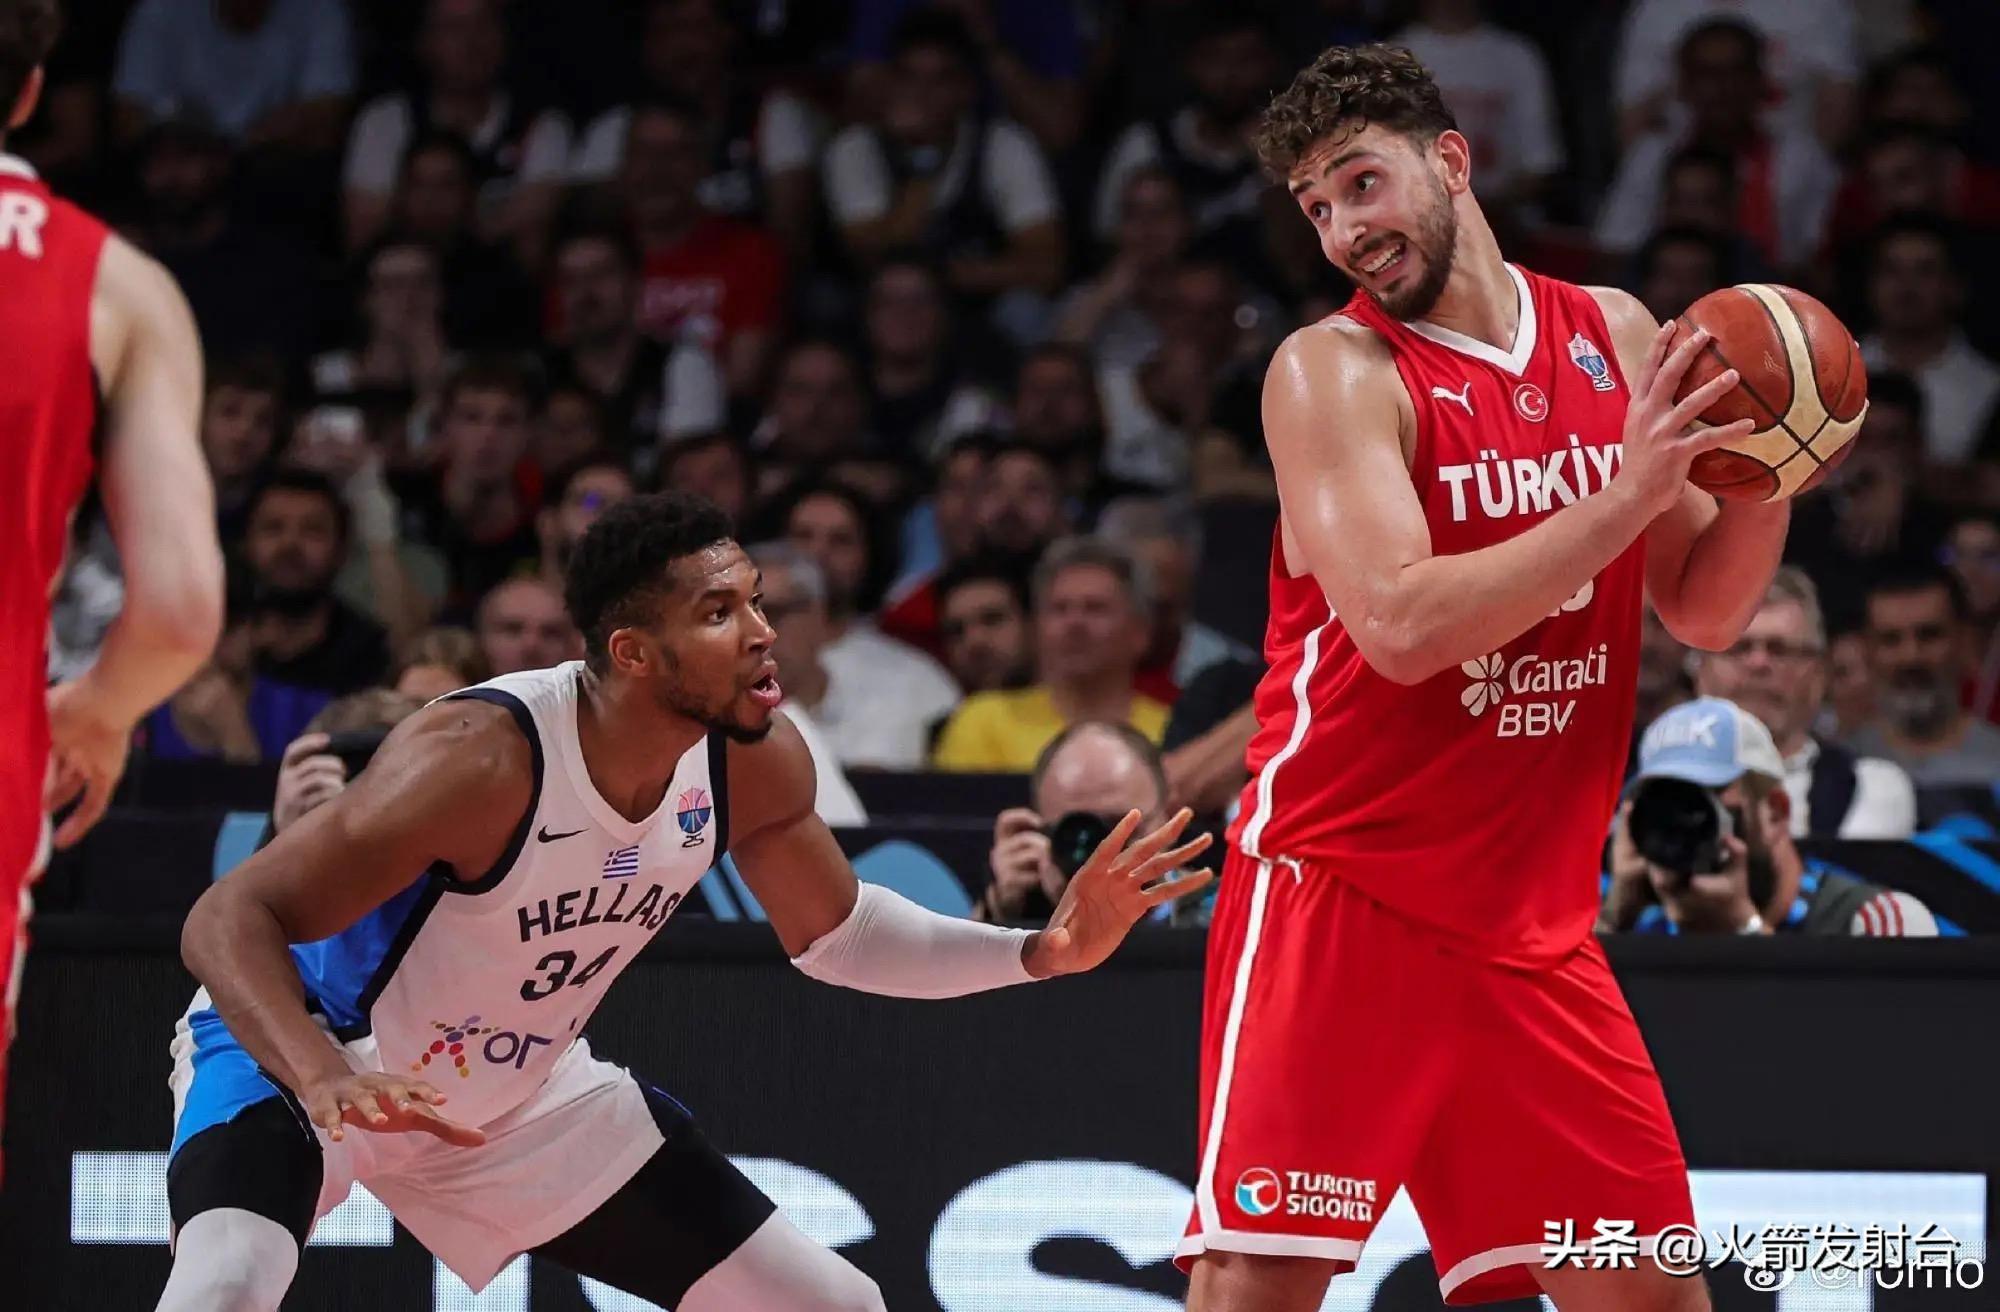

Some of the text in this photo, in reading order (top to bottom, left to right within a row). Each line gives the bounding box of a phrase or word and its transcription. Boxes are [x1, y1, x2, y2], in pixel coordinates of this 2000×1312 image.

[1438, 434, 1624, 522] TÜRKİY
[517, 883, 682, 942] HELLAS
[520, 945, 620, 1001] 34
